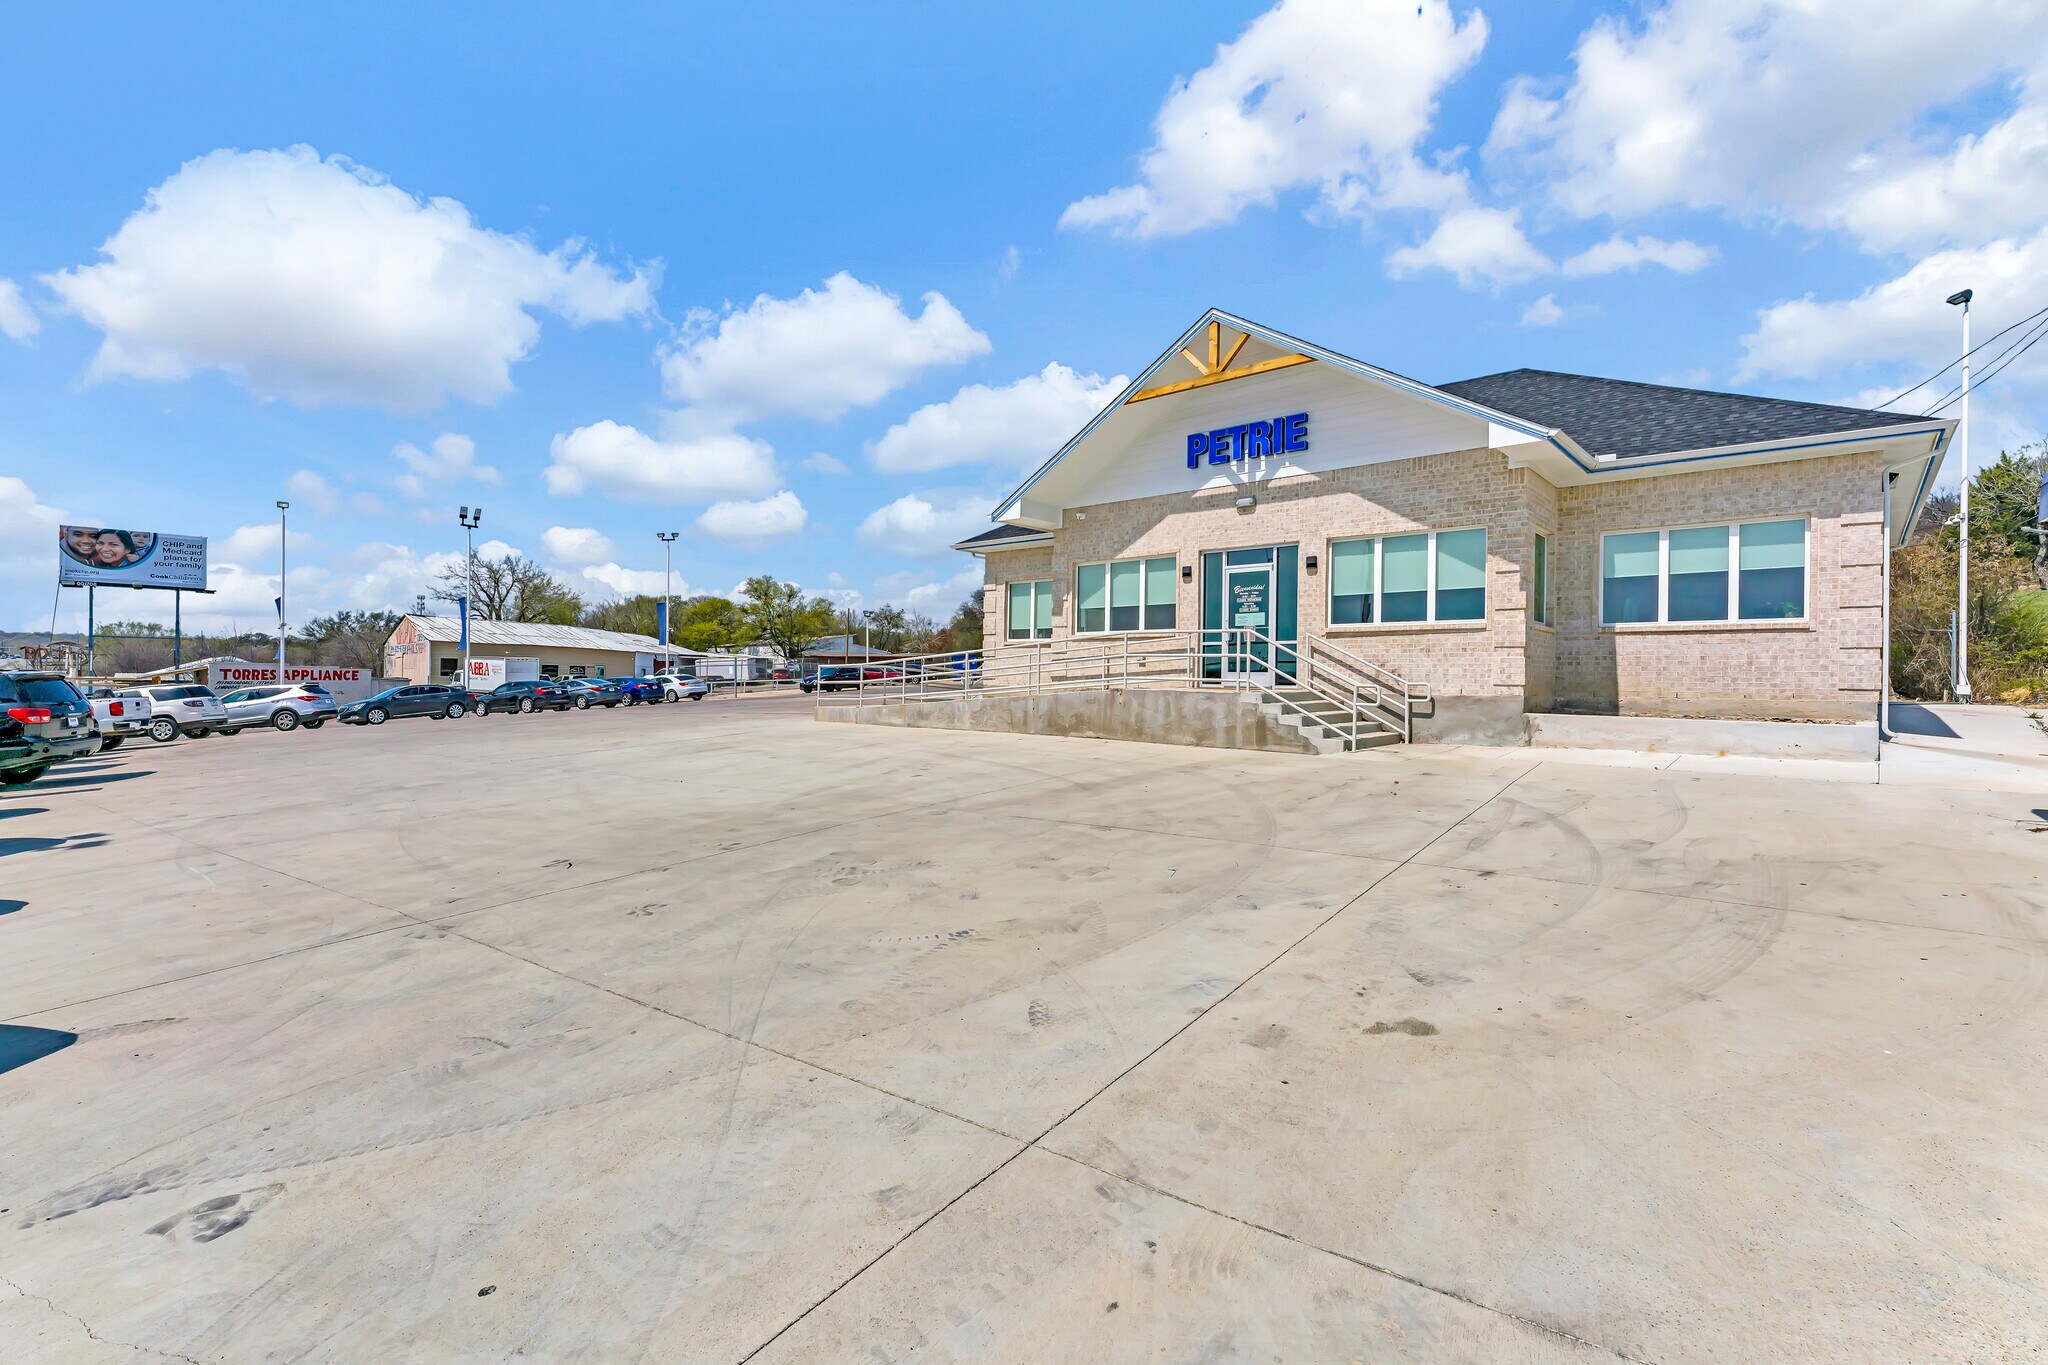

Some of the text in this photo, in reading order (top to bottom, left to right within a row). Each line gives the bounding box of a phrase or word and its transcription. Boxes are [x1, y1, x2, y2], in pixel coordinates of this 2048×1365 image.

[1187, 412, 1309, 469] PETRIE
[162, 540, 185, 548] CHIP
[162, 547, 203, 556] Medicaid
[163, 554, 188, 562] plans
[176, 562, 204, 570] family.
[469, 661, 490, 676] ABBA
[219, 668, 359, 681] TORRES APPLIANCE
